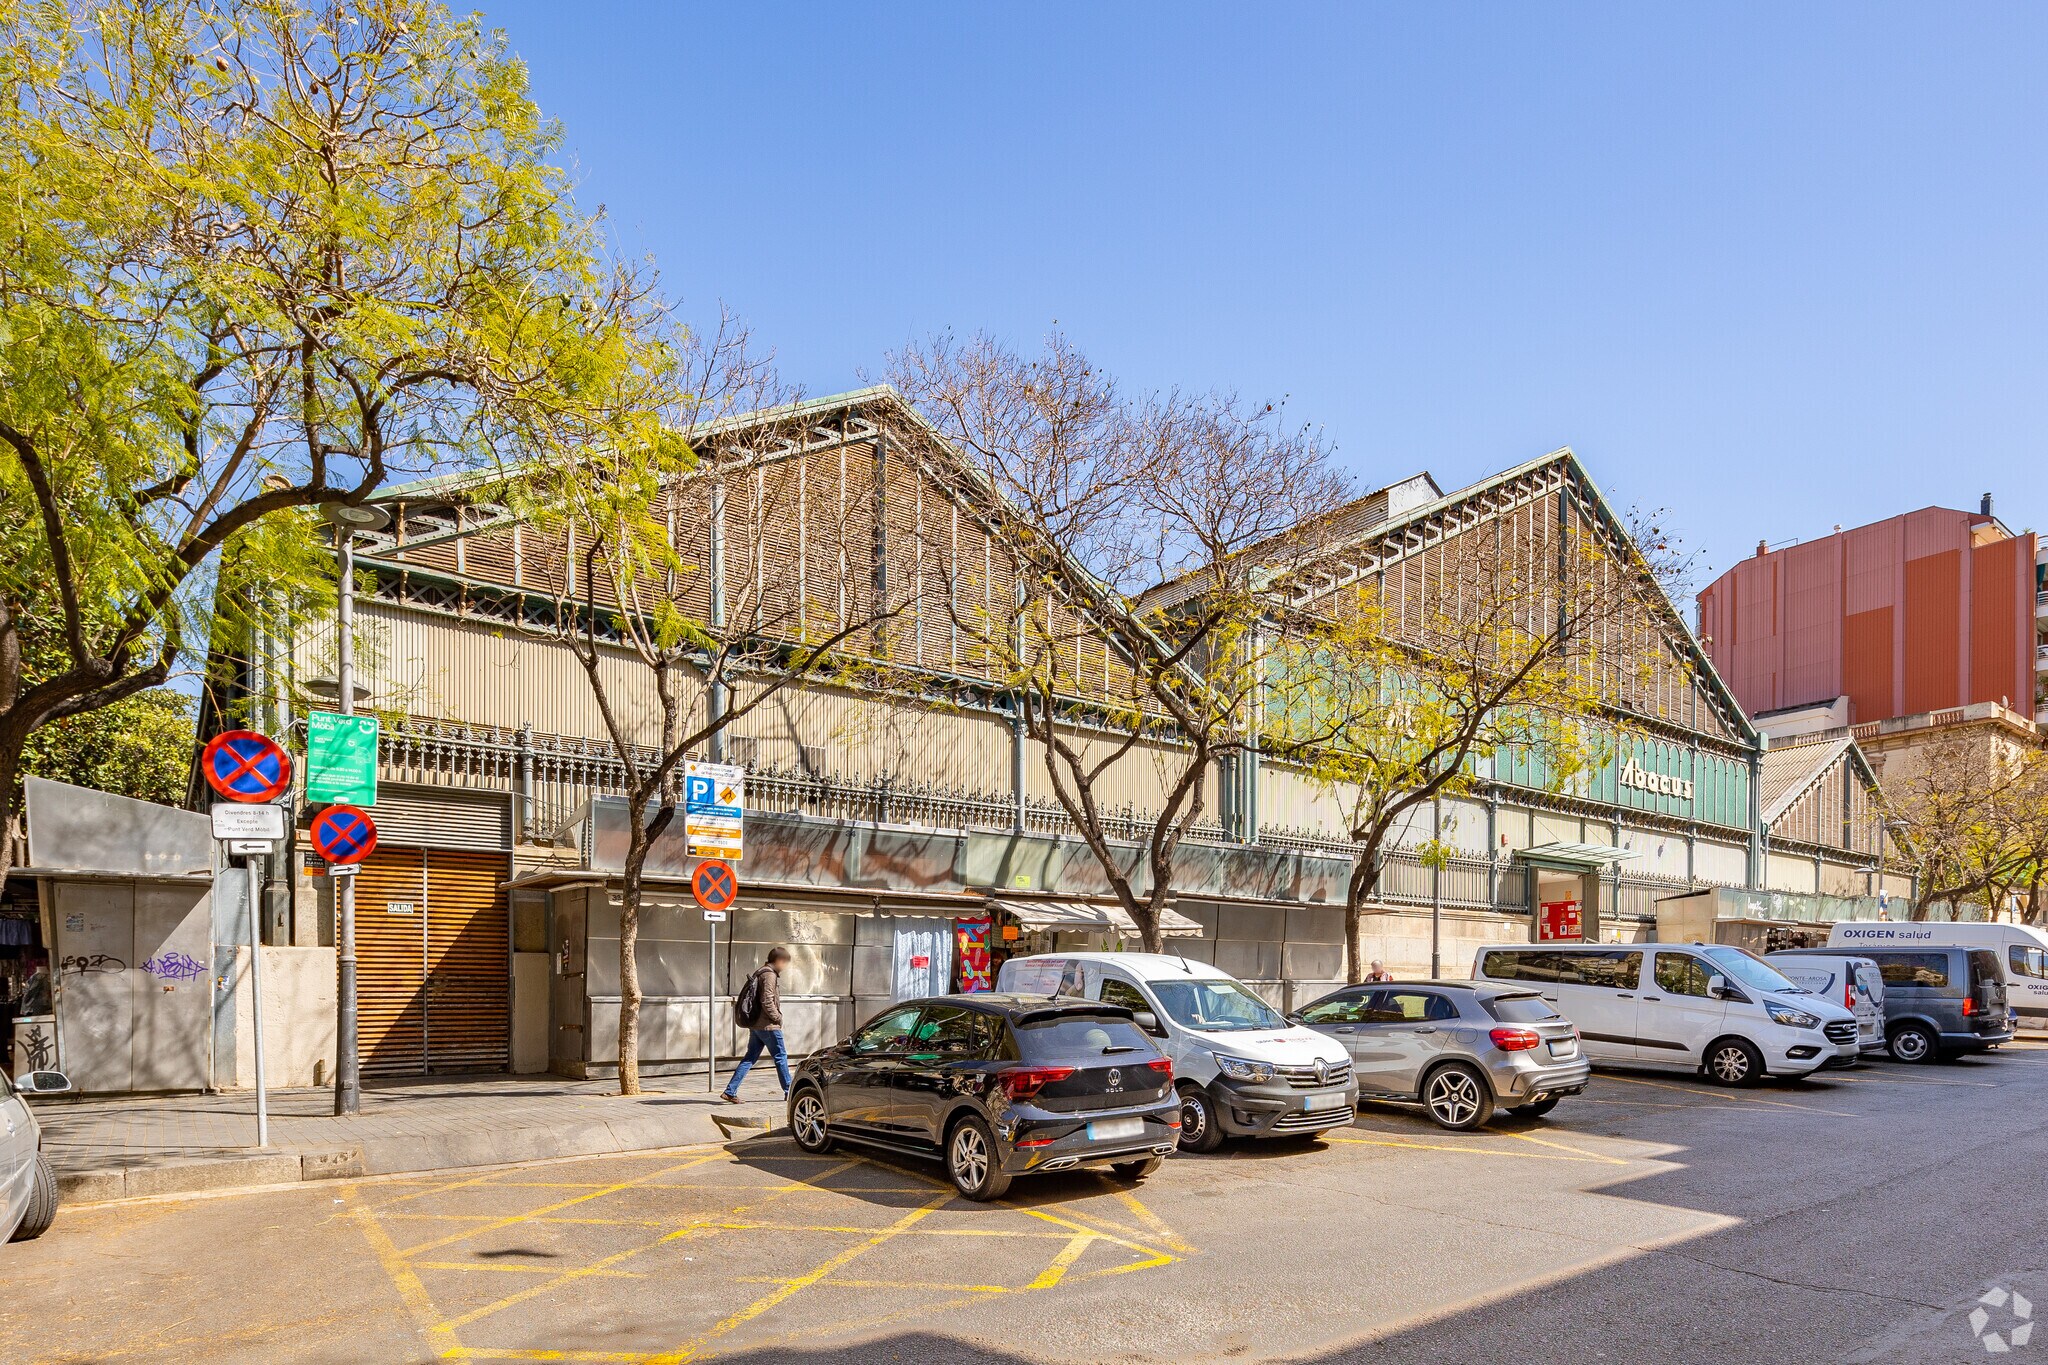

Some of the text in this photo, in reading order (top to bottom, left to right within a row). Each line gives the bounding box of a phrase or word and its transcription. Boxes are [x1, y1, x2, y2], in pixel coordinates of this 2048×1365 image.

[311, 713, 352, 726] Punt Verd
[311, 722, 335, 731] Mòbil
[1621, 756, 1692, 799] Abacus
[692, 780, 709, 801] P
[388, 904, 412, 914] SALIDA
[1843, 929, 1932, 940] OXIGEN salud
[1105, 1086, 1124, 1094] POLO
